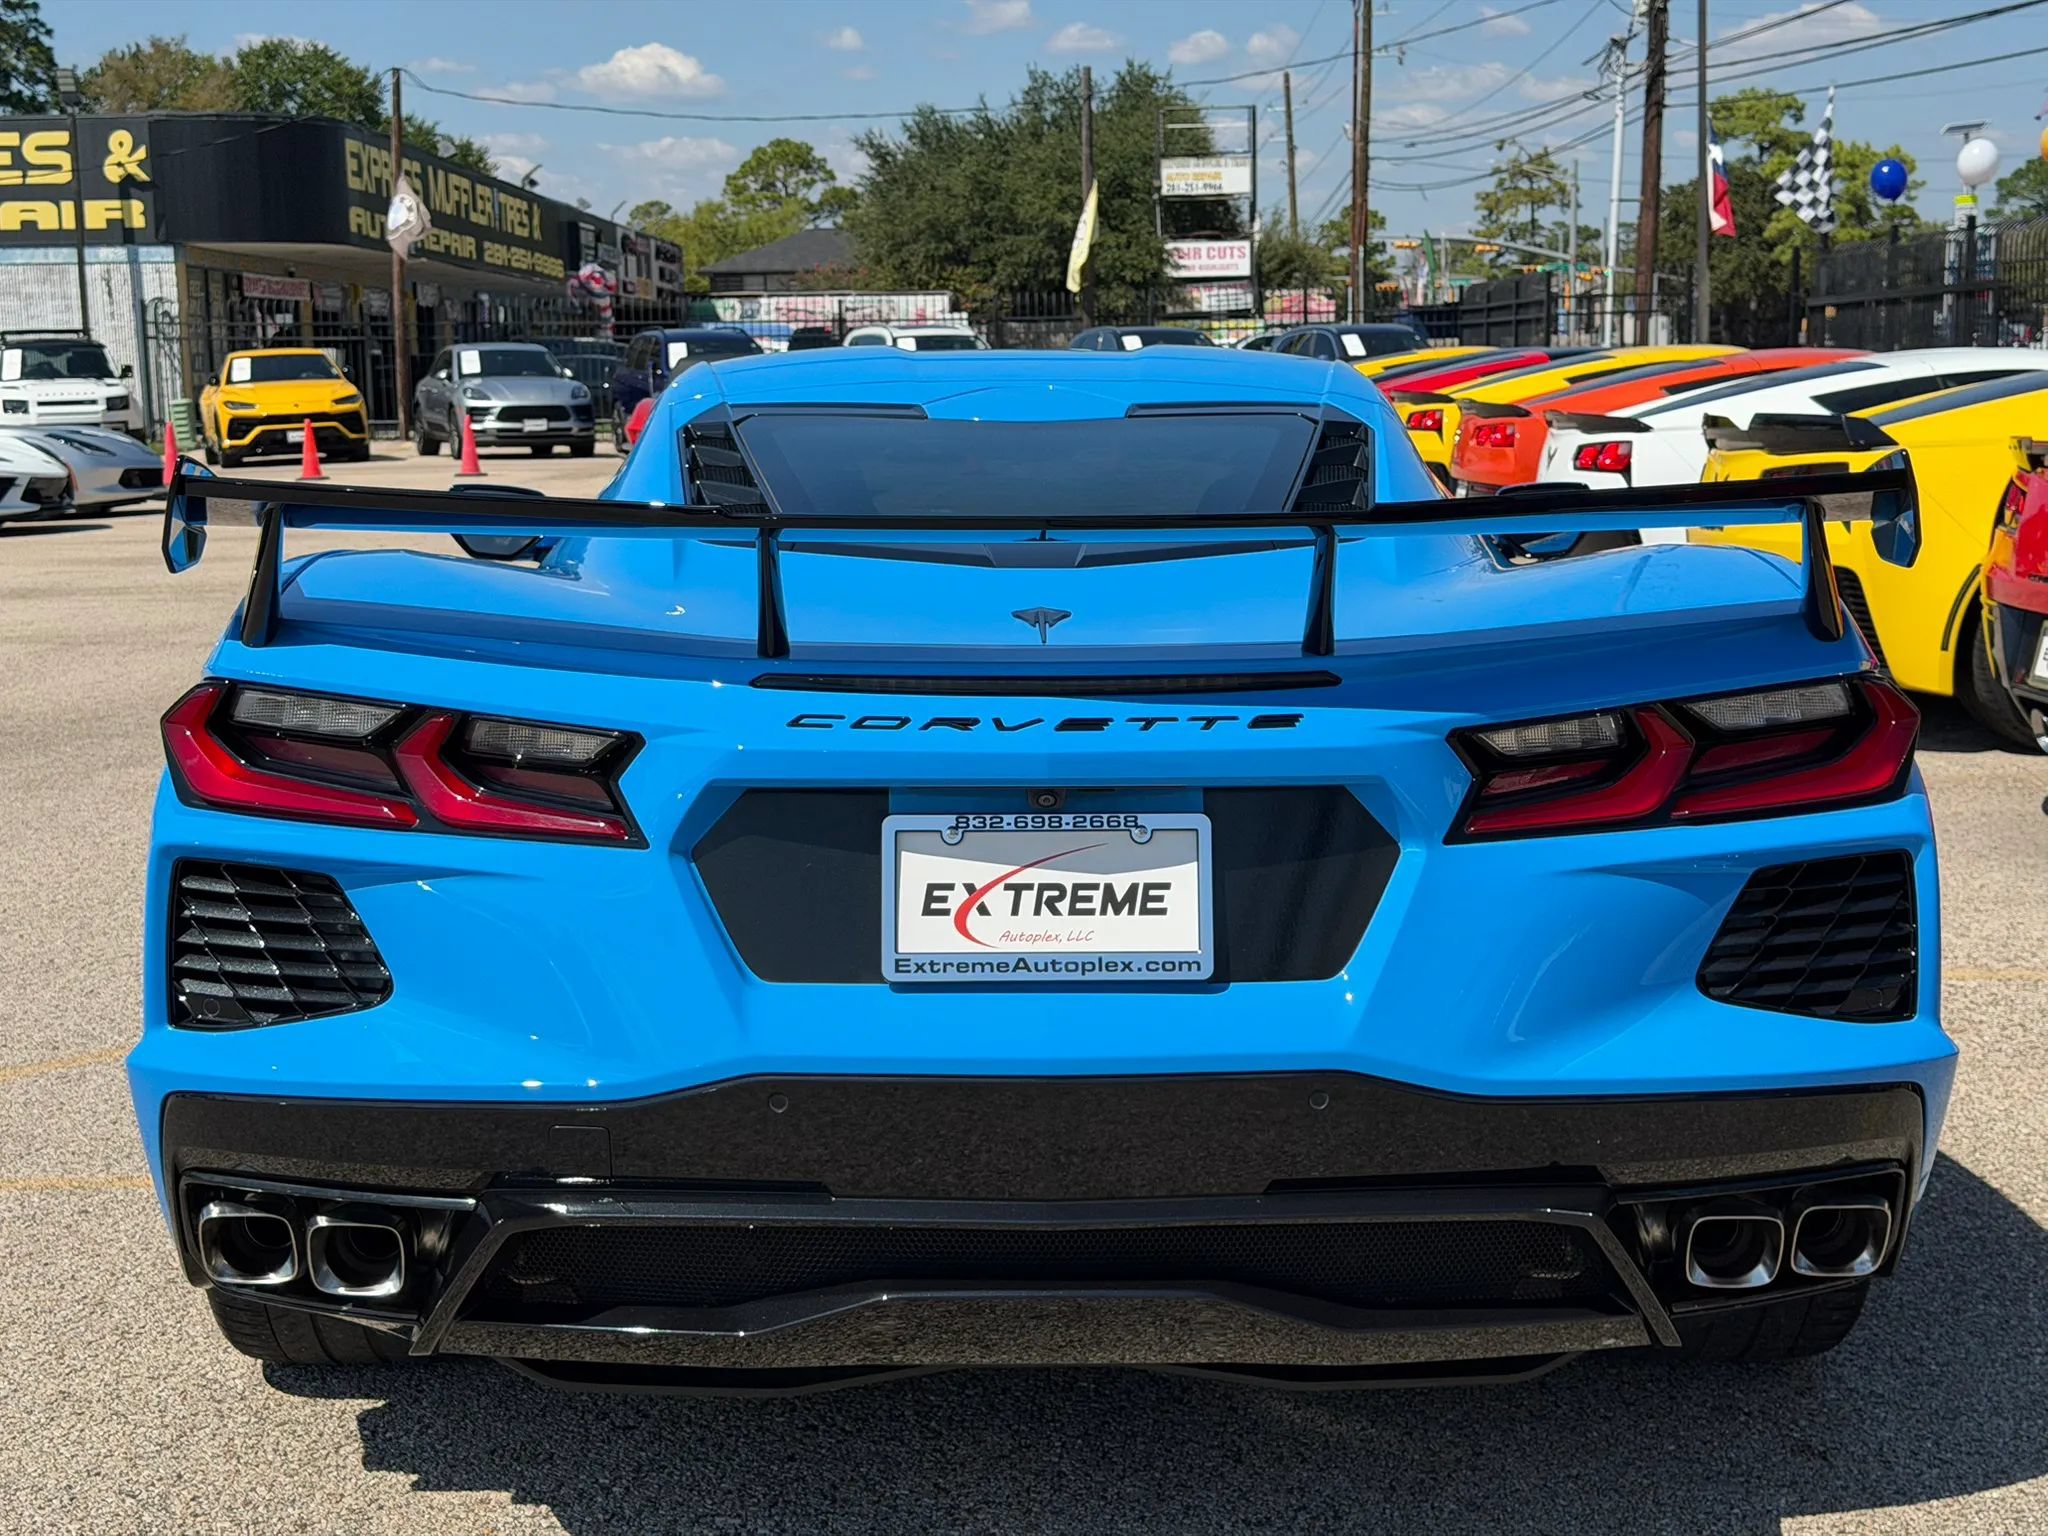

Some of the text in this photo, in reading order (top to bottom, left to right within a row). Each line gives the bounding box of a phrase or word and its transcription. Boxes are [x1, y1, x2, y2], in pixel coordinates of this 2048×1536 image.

[103, 129, 151, 184] &
[345, 137, 423, 202] EXPRSS
[428, 165, 494, 228] MUFFLER
[0, 199, 146, 231] AIR
[1206, 245, 1246, 260] CUTS
[786, 713, 1305, 732] CORVETTE
[955, 815, 1138, 829] 832-698-2668
[921, 882, 1172, 917] EXTREME
[999, 930, 1095, 945] Autoplex, LLC
[894, 957, 1202, 976] ExtremeAutoplex.com
